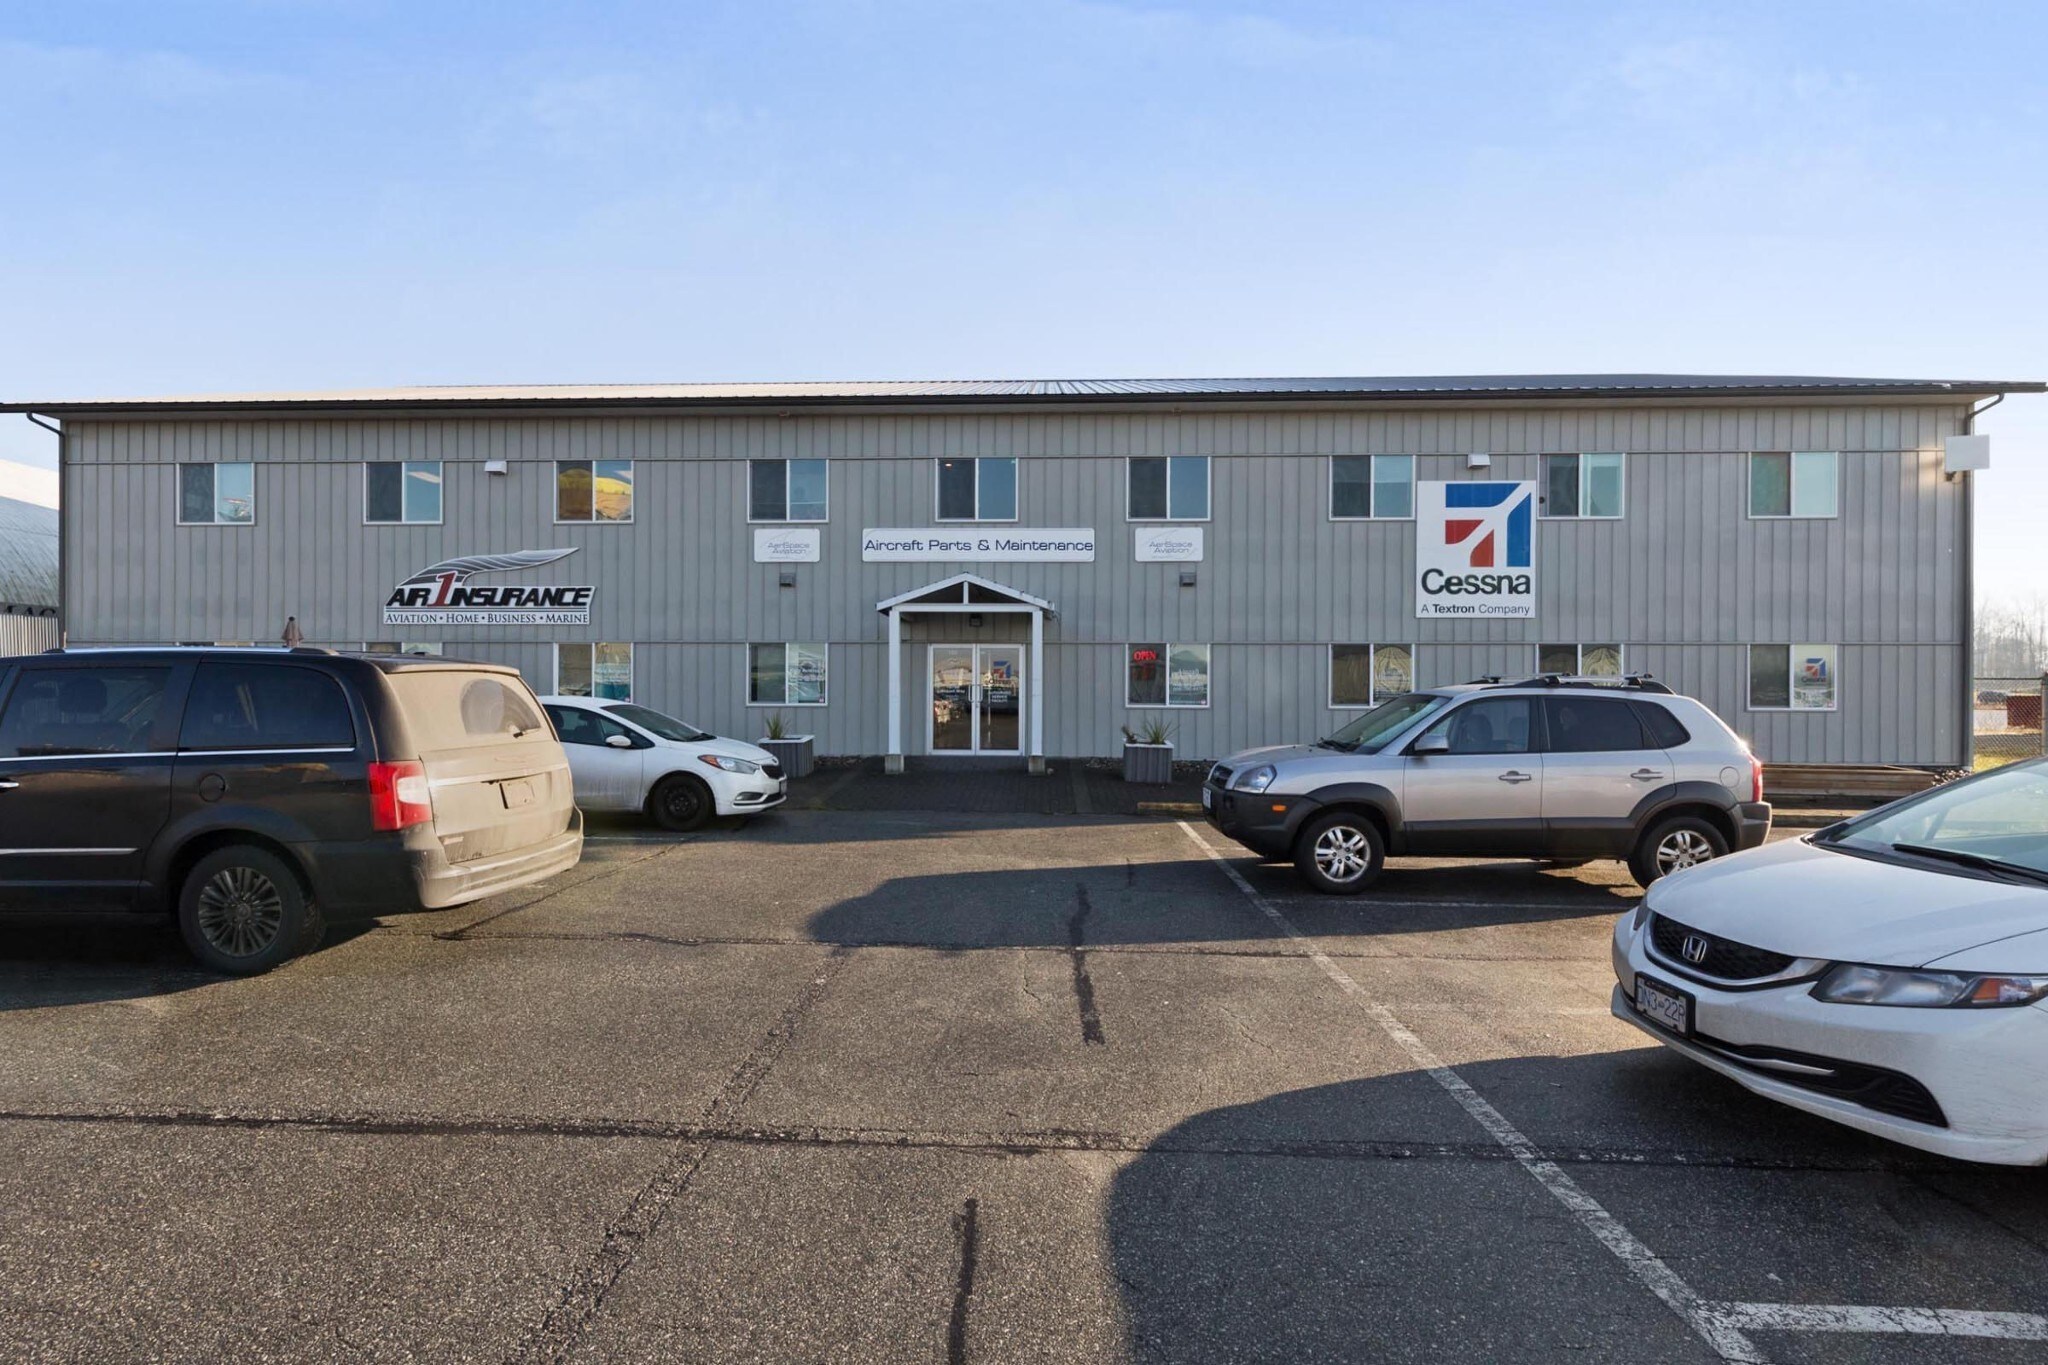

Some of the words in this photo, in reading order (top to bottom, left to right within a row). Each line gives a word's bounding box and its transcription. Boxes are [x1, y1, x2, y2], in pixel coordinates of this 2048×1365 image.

[864, 539, 924, 551] Aircraft
[928, 539, 972, 551] Parts
[977, 539, 991, 551] &
[995, 539, 1094, 551] Maintenance
[1421, 568, 1531, 595] Cessna
[1420, 604, 1430, 614] A
[1432, 603, 1475, 614] Textron
[1478, 603, 1530, 616] Company
[385, 613, 438, 624] AVIATION
[446, 613, 480, 624] HOME
[487, 613, 537, 624] BUSINESS
[545, 613, 589, 624] MARINE
[1133, 650, 1157, 661] OPEN
